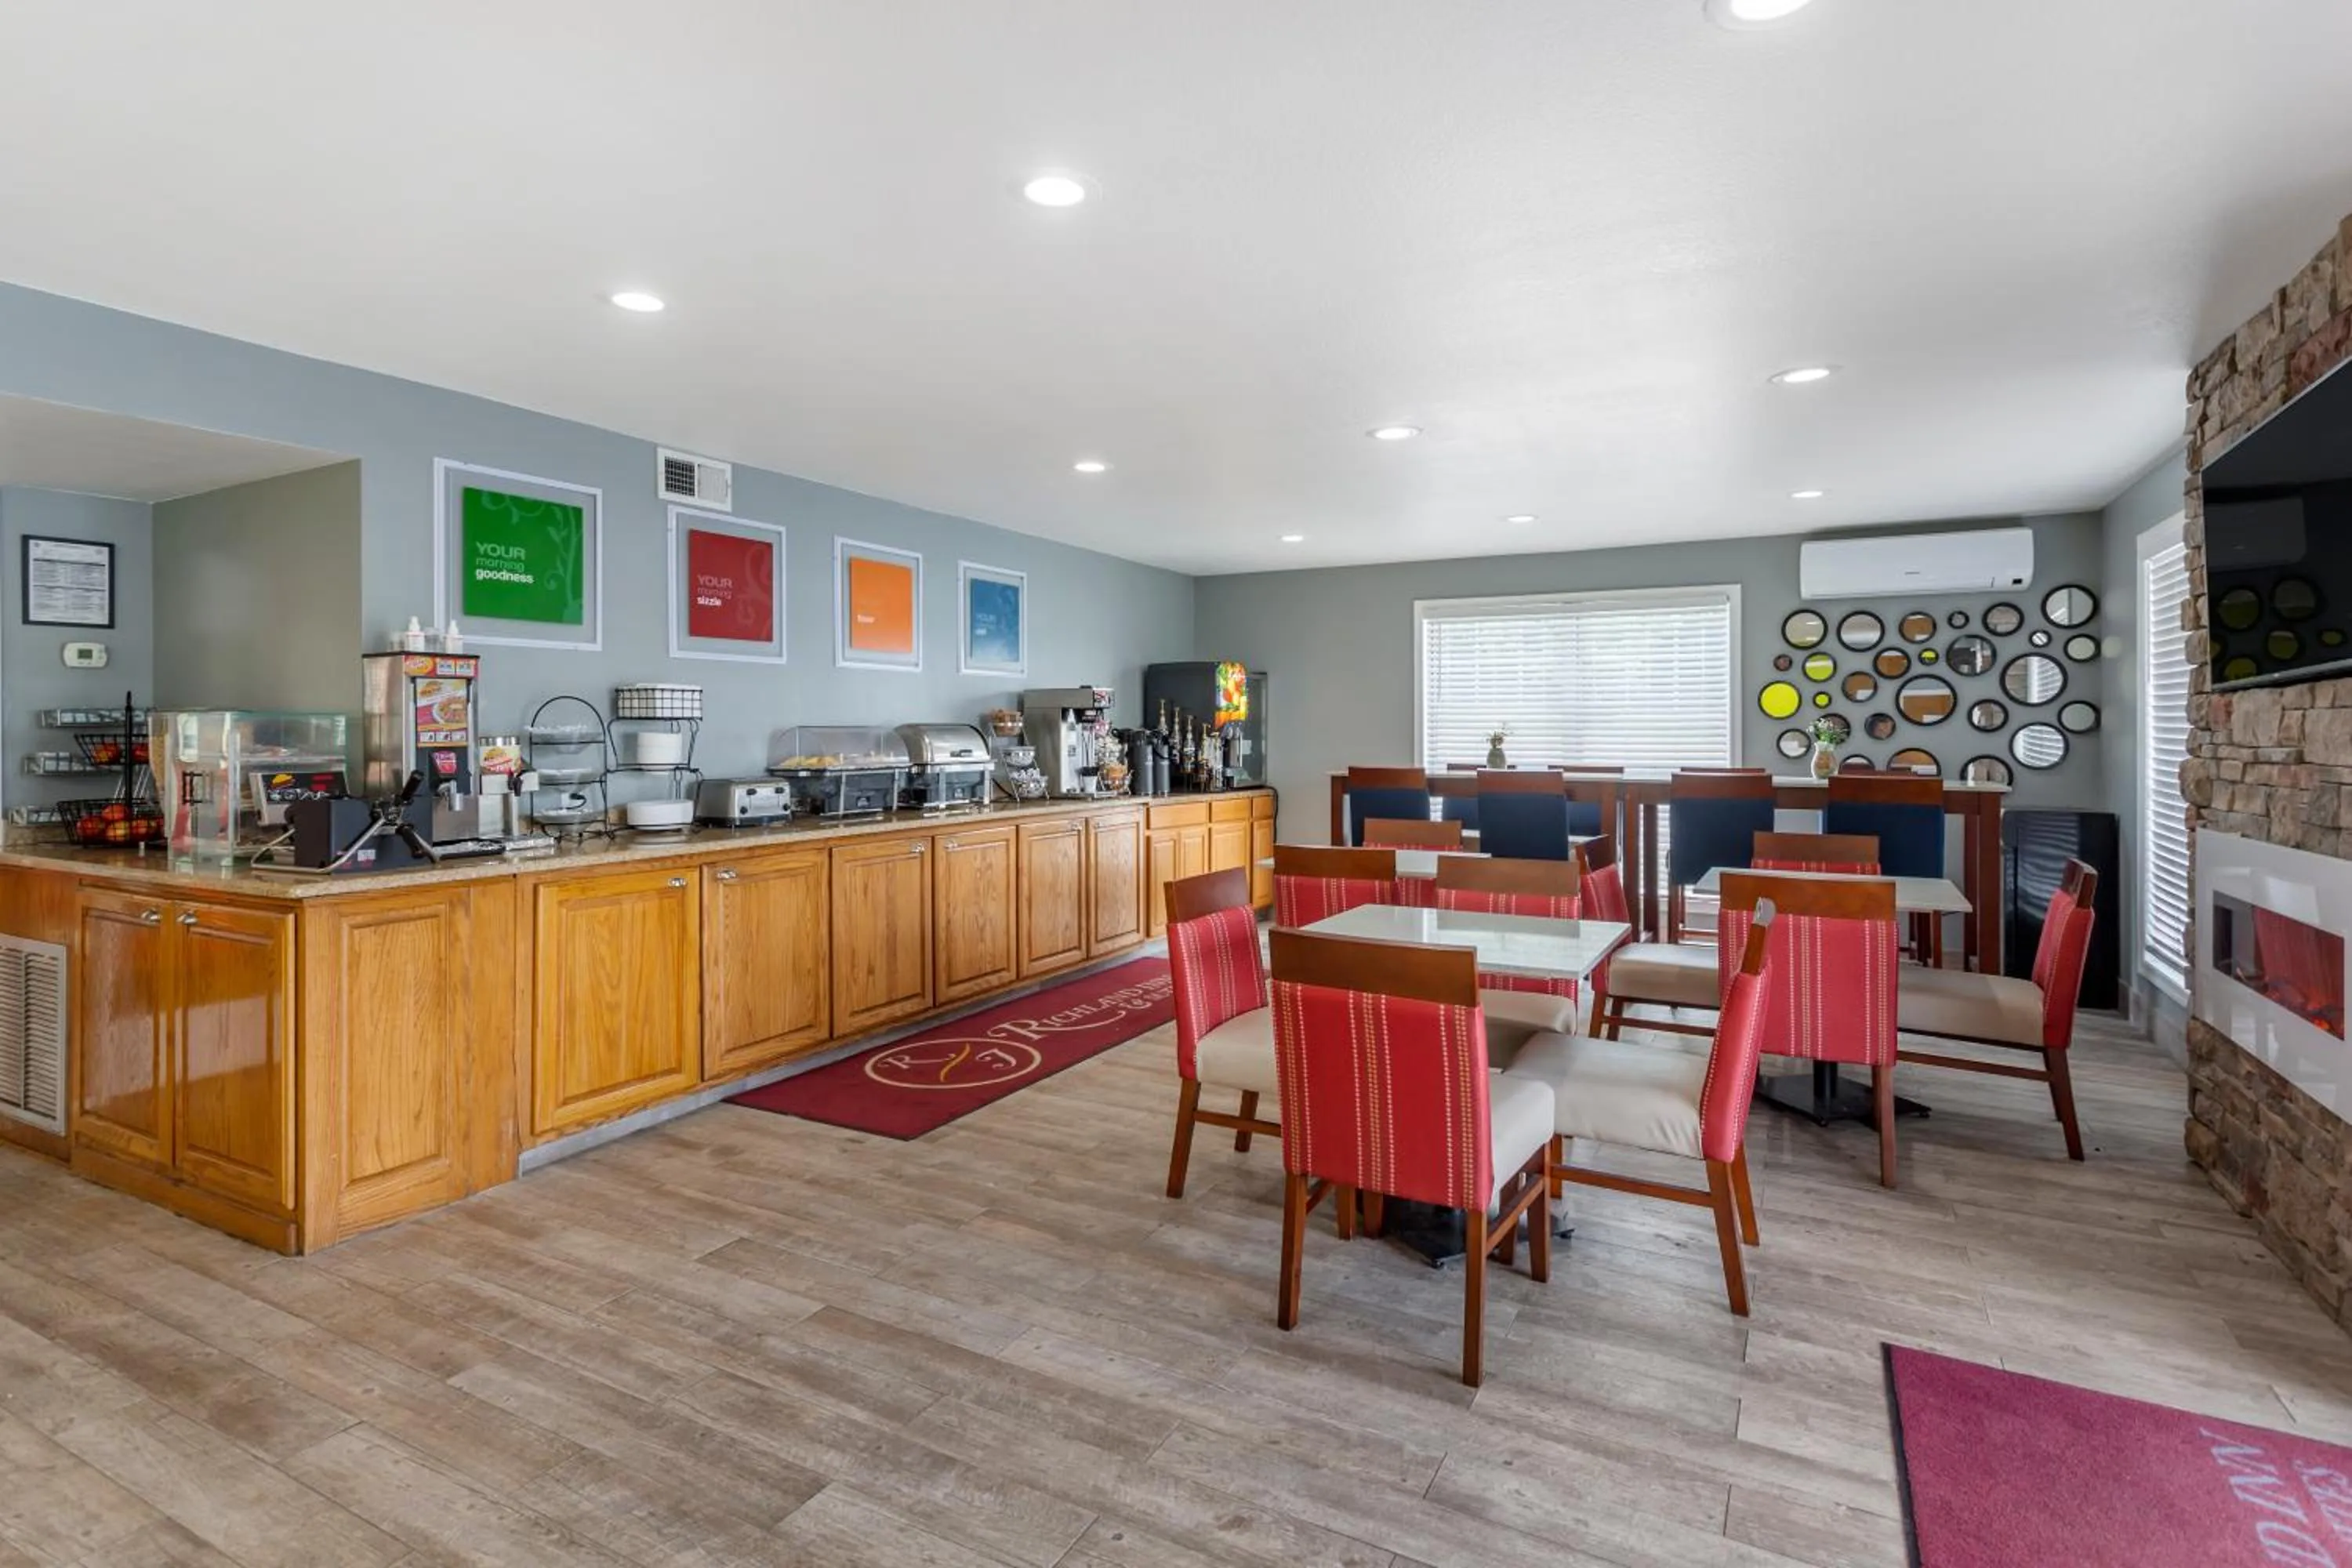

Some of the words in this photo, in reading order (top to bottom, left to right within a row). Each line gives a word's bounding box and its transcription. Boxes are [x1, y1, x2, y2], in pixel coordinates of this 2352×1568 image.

[476, 541, 525, 561] YOUR
[476, 557, 524, 572] morning
[475, 568, 534, 583] goodness
[698, 574, 732, 588] YOUR
